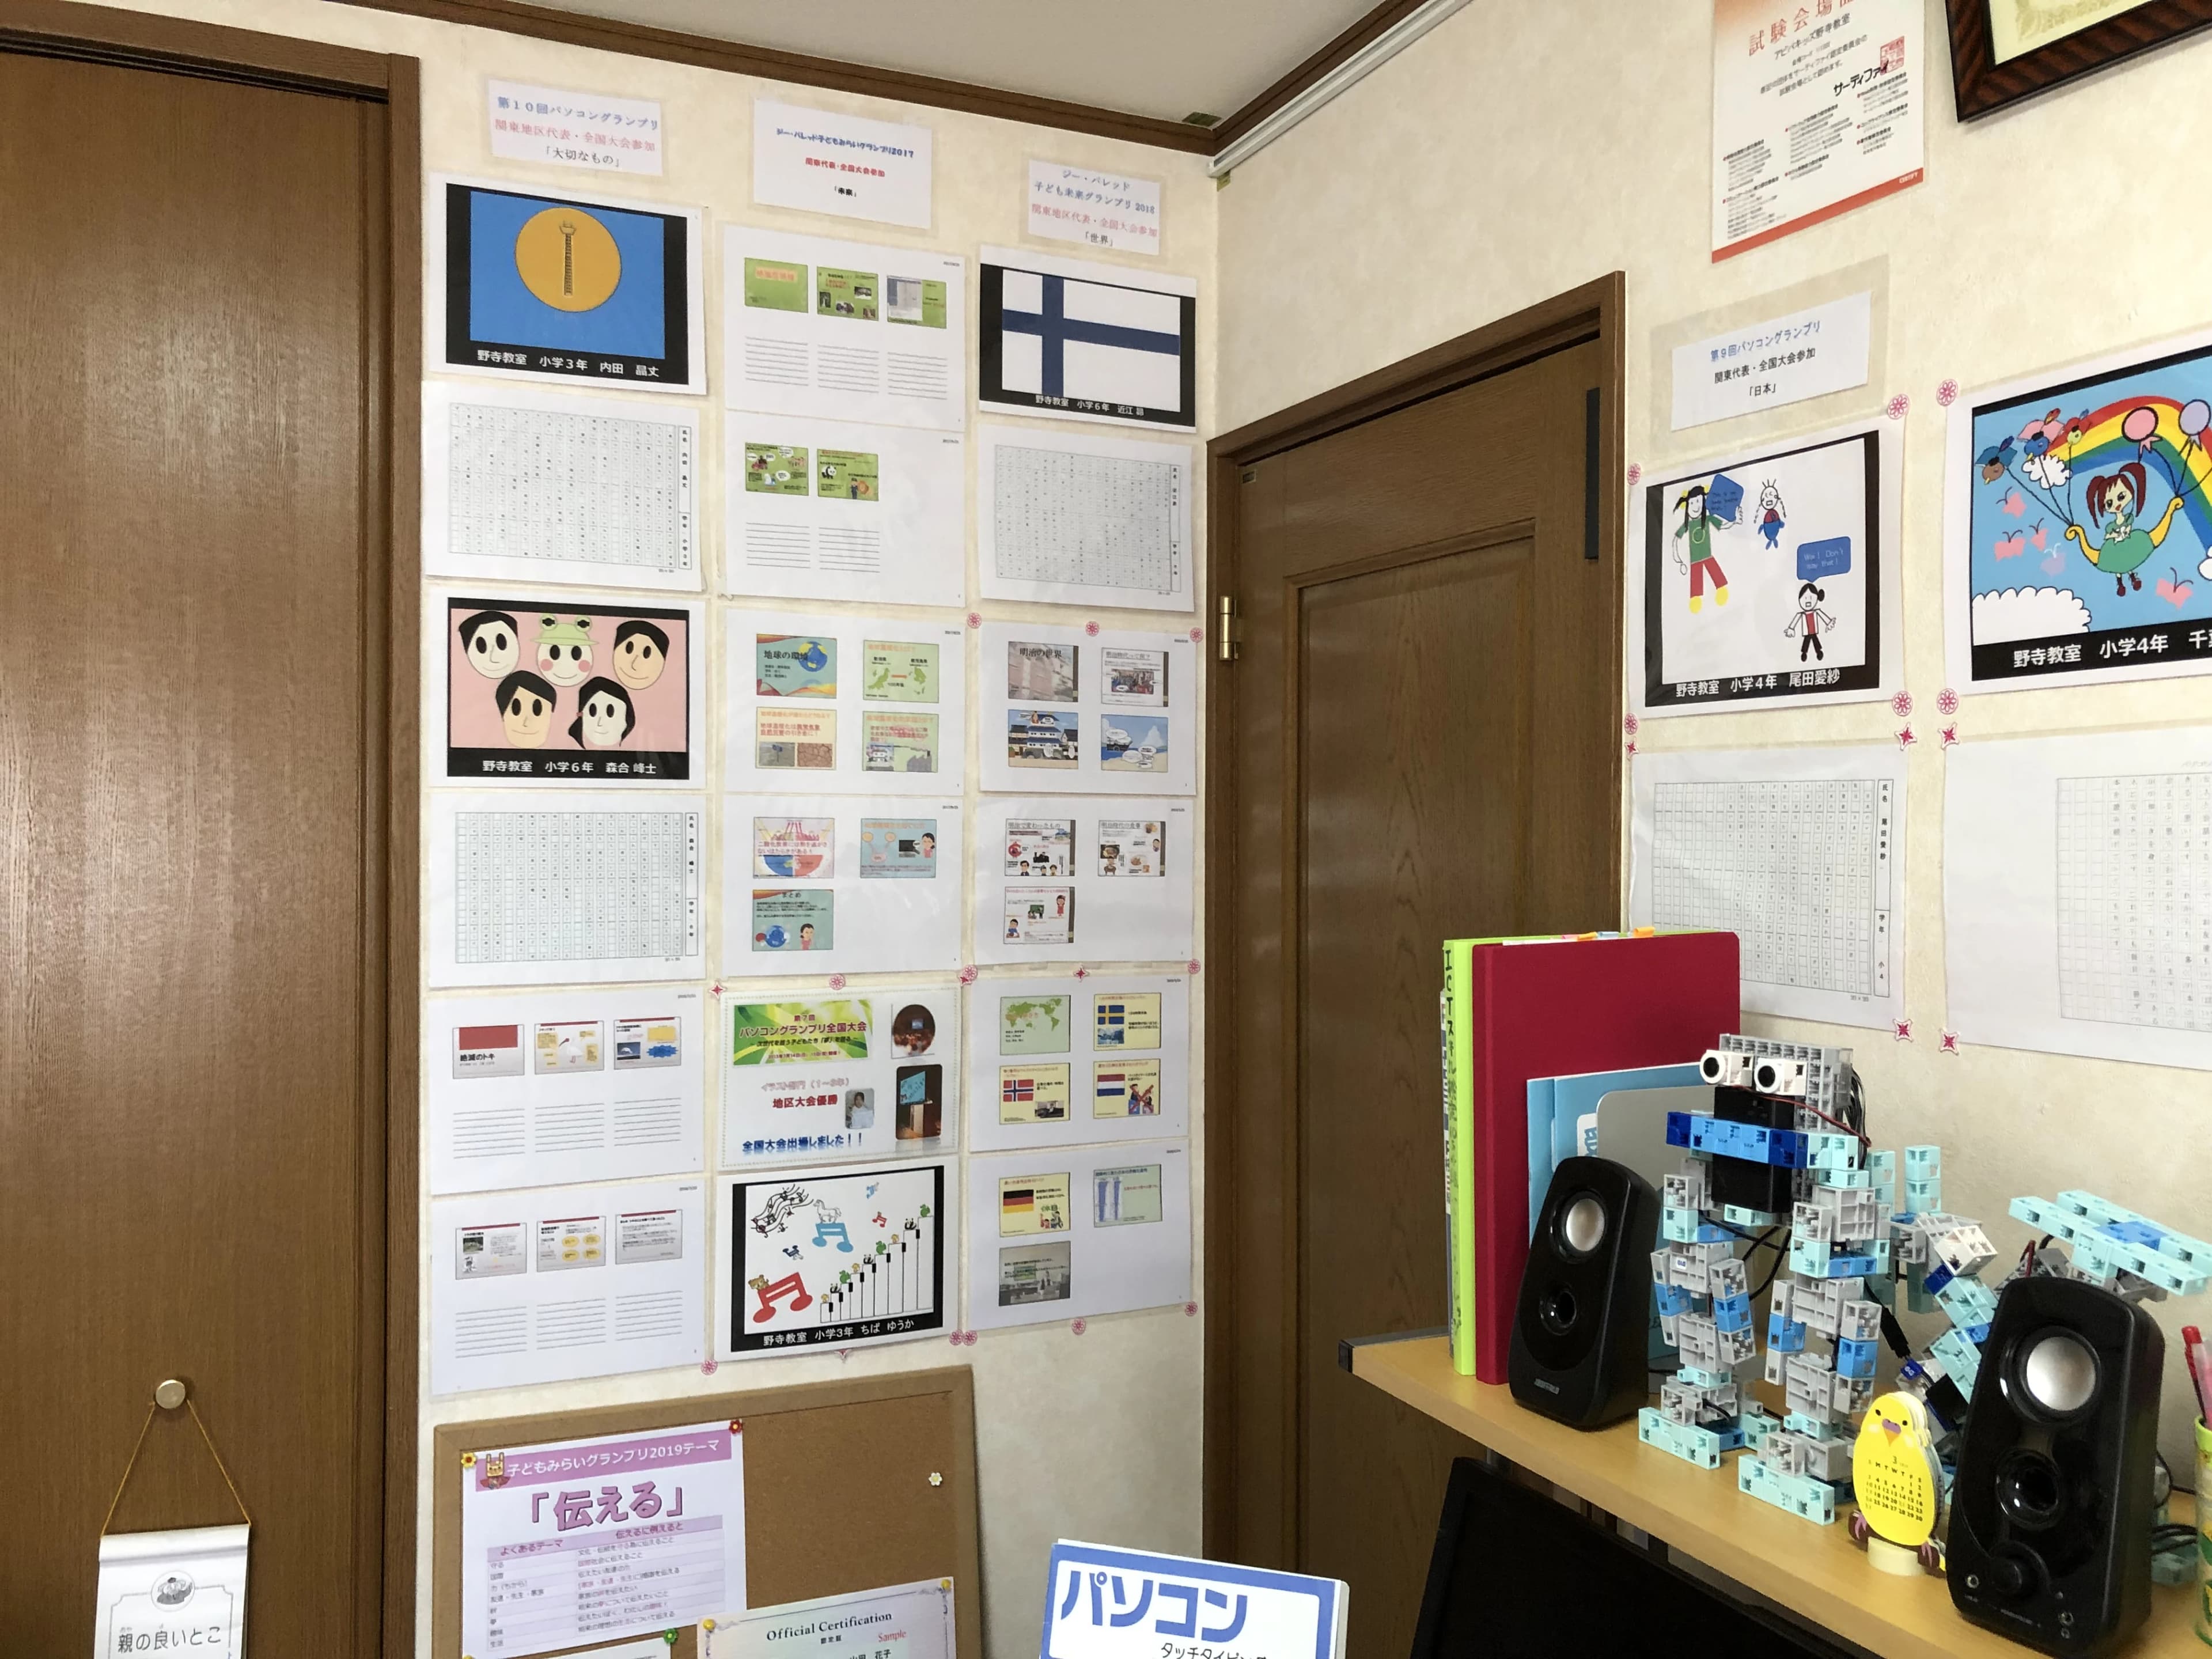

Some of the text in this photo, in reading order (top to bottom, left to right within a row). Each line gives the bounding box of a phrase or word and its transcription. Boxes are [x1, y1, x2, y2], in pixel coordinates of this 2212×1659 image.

[1834, 59, 1889, 97] サーティファイ
[495, 119, 656, 151] 関東地区代表・全国大会参加
[547, 146, 619, 167] 「大切なもの」
[805, 157, 885, 177] 関東代表・全国大会参加
[1032, 203, 1157, 237] 関東地区代表・全国大会参加
[1085, 231, 1113, 247] 「世界」
[1710, 320, 1821, 363] 第9回パソコングランプリ
[477, 349, 527, 365] 野寺教室
[539, 356, 588, 371] 小学3年
[600, 362, 623, 374] 内田
[1714, 347, 1816, 384] 関東代表・全国大会参加
[1749, 383, 1777, 397] 「日本」
[1036, 395, 1069, 407] 野寺教室
[1077, 401, 1110, 411] 小学6年
[1118, 405, 1134, 415] 近江
[1019, 647, 1062, 658] 明治の世界
[2013, 629, 2212, 668] 野寺教室 小学4年 千
[1676, 668, 1840, 697] 野寺教室 小学4年 尾田愛紗
[482, 760, 657, 775] 野寺教室 小学6年 森合 峰士
[740, 1021, 867, 1037] パソコングランプリ全国大会
[460, 1053, 495, 1062] 絶滅のトキ
[772, 1094, 838, 1108] 地区大会優勝
[763, 1320, 914, 1346] 野寺教室 小学3年 ちば ゆうか
[507, 1440, 720, 1478] 子どもみらいグランプリ2019テーマ
[531, 1480, 683, 1532] 「伝える」
[501, 1539, 563, 1556] よくあるテーマ
[1060, 1570, 1248, 1643] パソコン
[118, 1626, 221, 1653] 親の良いとこ
[767, 1613, 892, 1641] Official Certification
[877, 1629, 907, 1643] Sample
